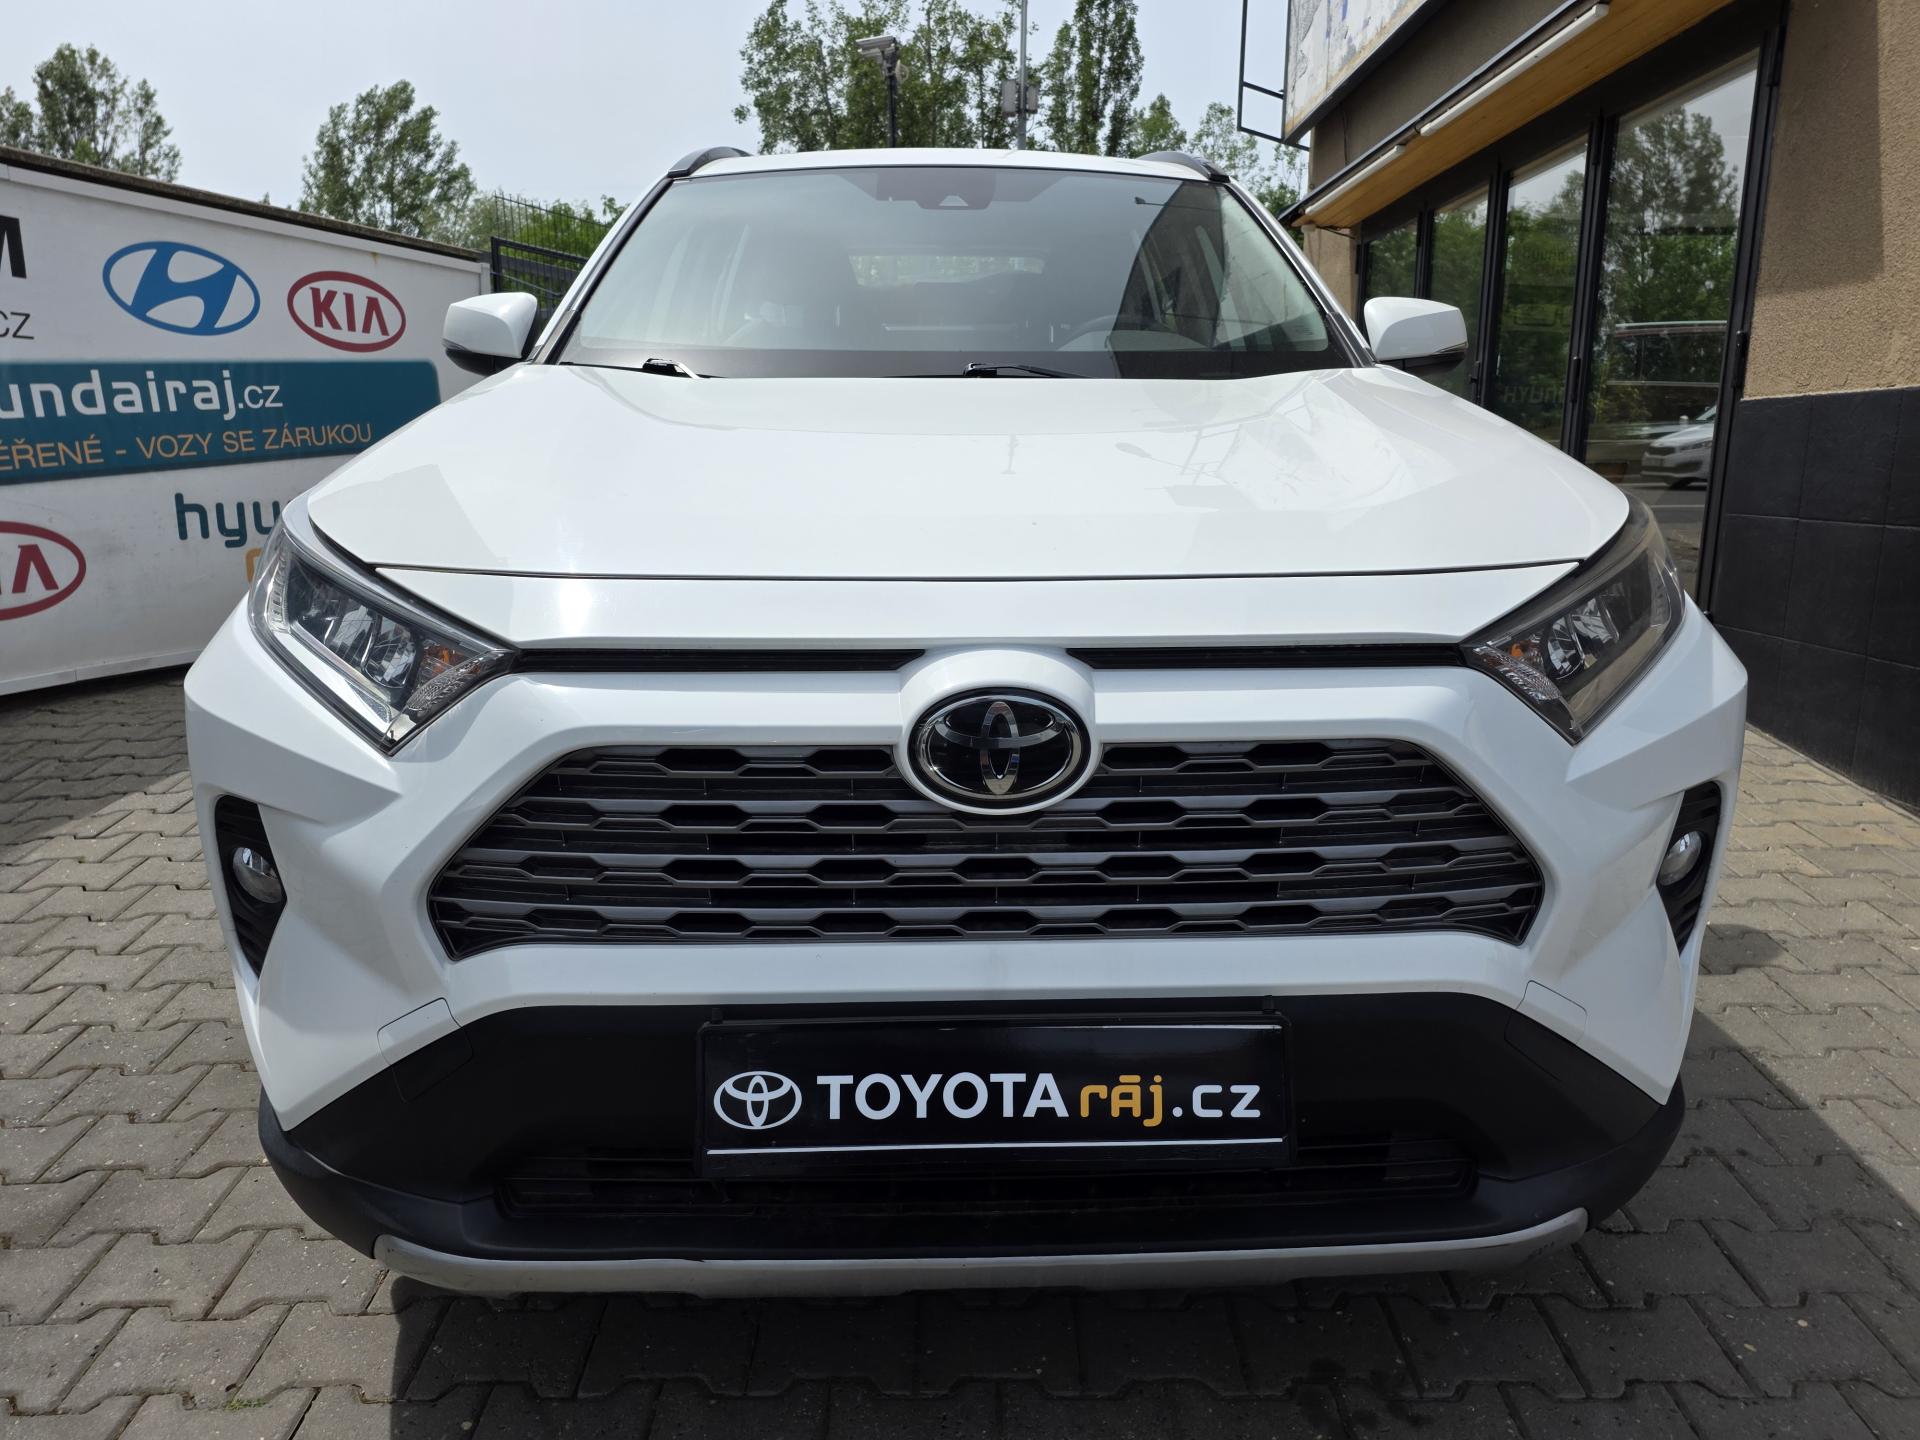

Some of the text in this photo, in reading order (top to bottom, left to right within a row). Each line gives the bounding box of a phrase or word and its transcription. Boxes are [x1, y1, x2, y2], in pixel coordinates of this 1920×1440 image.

[309, 286, 390, 337] KIA
[136, 432, 212, 459] VOZY
[223, 430, 256, 453] SE
[262, 422, 372, 450] ZÁRUKOU
[175, 492, 282, 549] hyu
